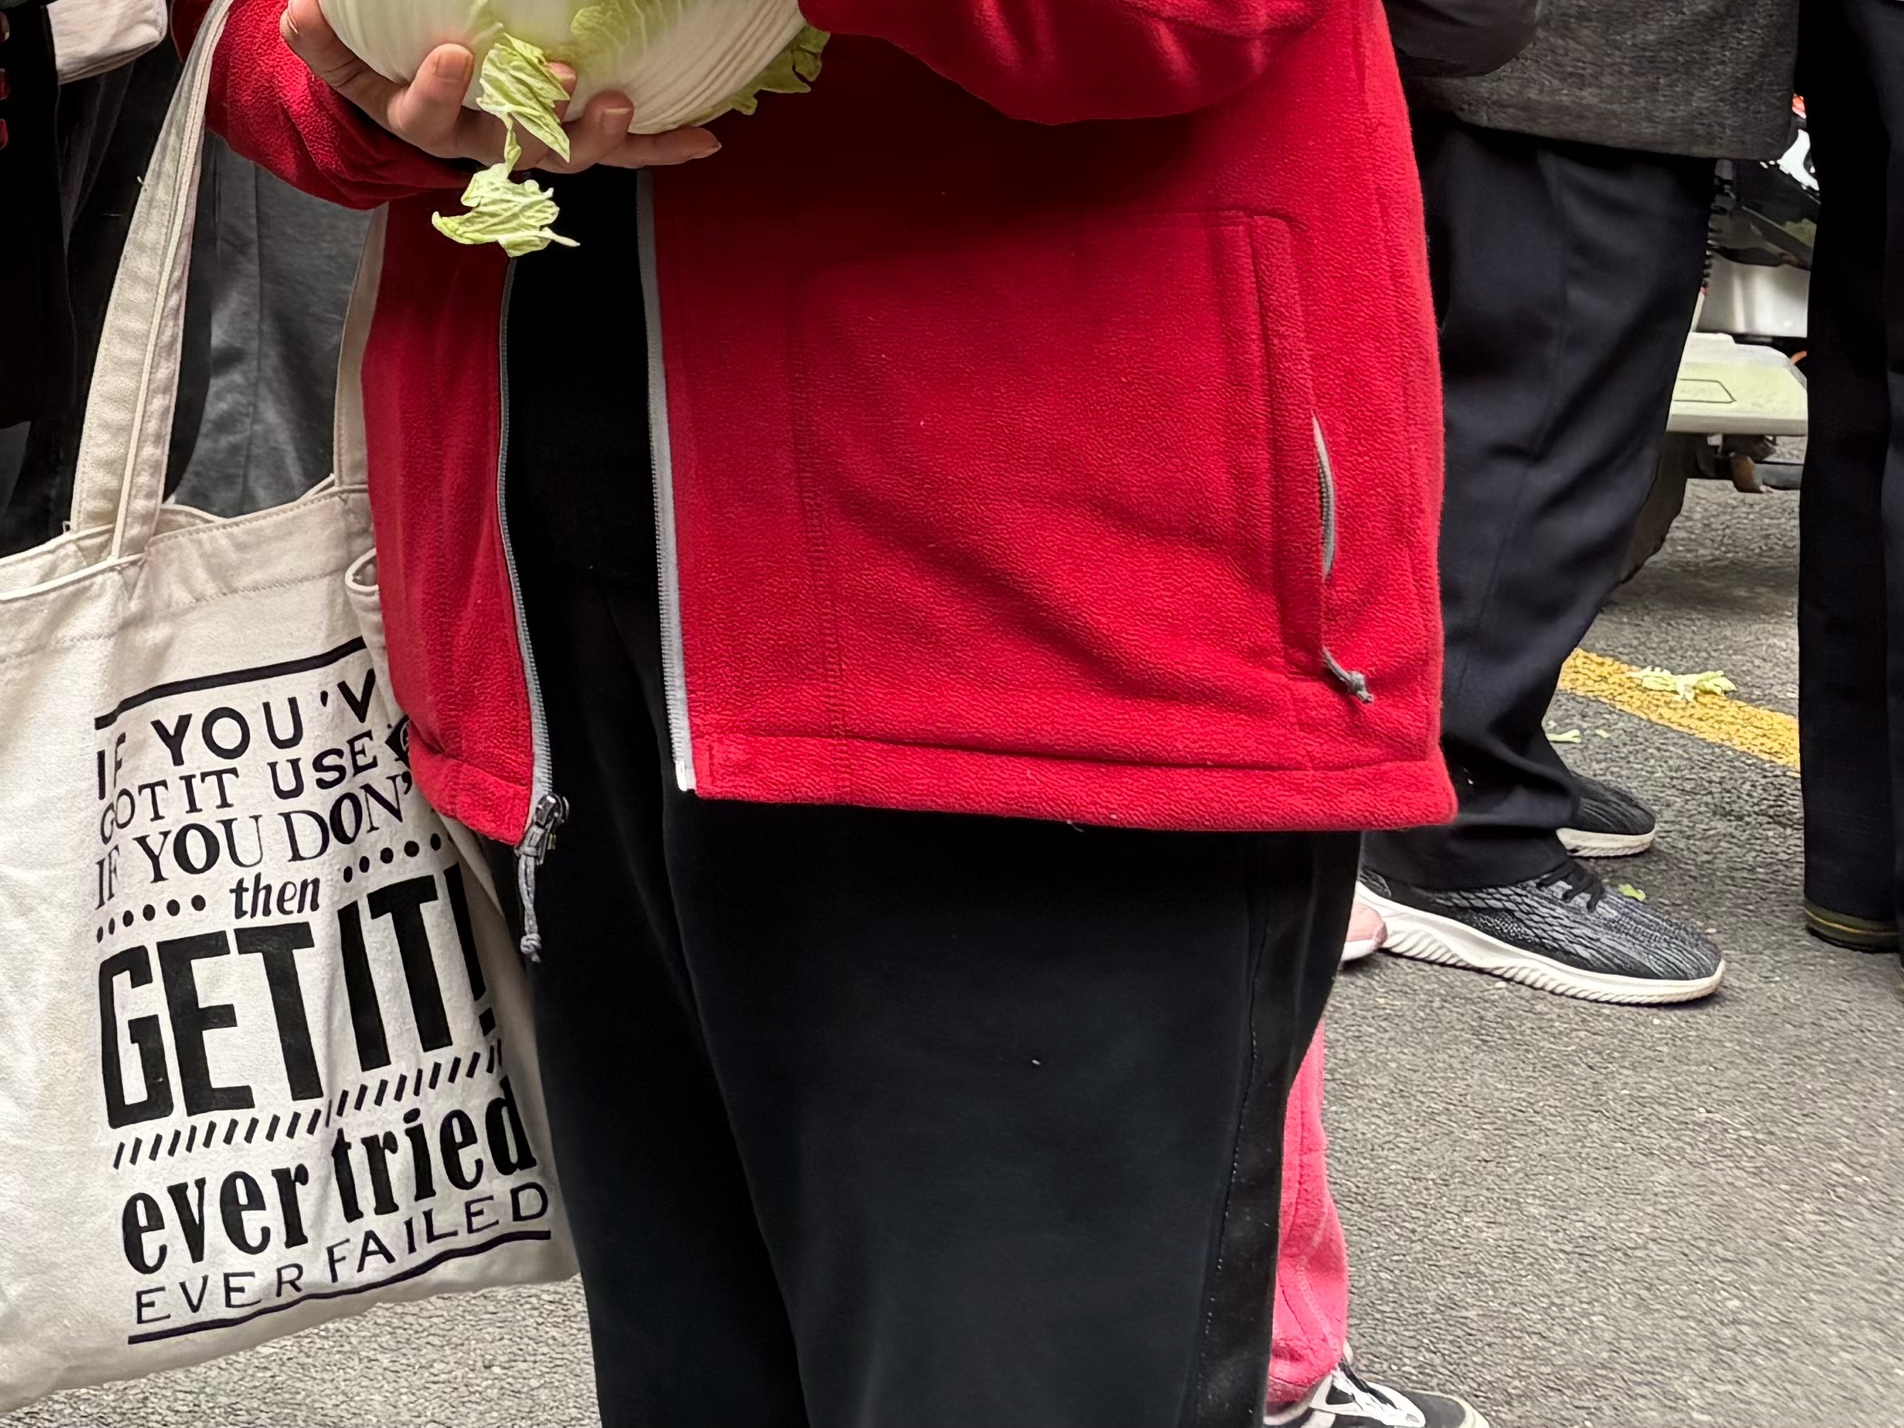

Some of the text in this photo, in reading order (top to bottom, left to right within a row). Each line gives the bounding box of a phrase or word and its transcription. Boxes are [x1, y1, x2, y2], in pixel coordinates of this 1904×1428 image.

[97, 732, 126, 800] IF
[151, 668, 376, 766] YOU'V
[101, 779, 168, 845] GOT
[268, 730, 378, 800] USE
[95, 770, 413, 910] IF YOU DON'
[229, 872, 320, 920] then
[98, 861, 497, 1129] GET IT!
[122, 1075, 537, 1275] ever tried
[136, 1181, 549, 1325] EVER FAILED
